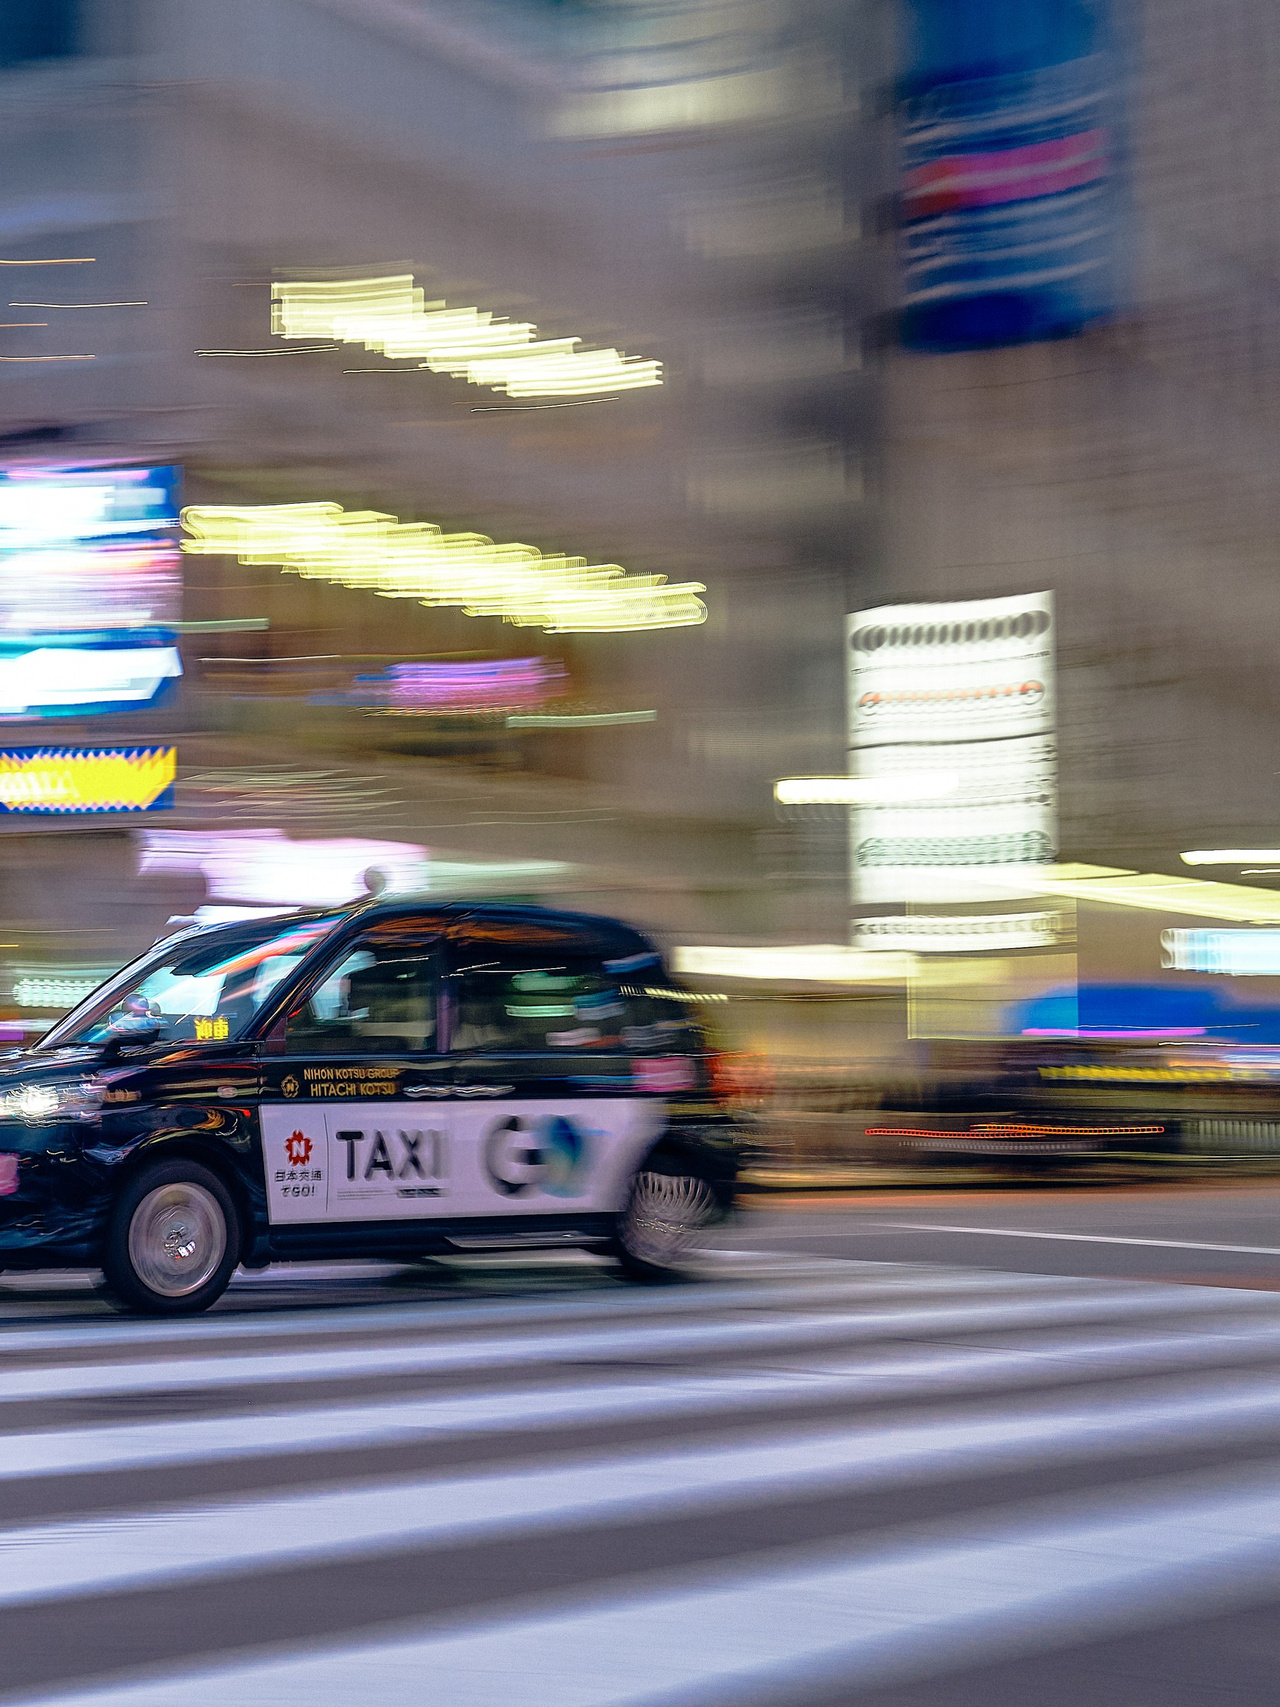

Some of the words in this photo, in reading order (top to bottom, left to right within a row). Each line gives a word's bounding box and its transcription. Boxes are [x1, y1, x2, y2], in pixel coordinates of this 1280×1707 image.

[303, 1069, 334, 1080] NIHON
[336, 1068, 366, 1079] KOTSU
[310, 1083, 356, 1097] HITACHI
[360, 1082, 396, 1095] KOTSU
[336, 1131, 446, 1181] TAXI
[275, 1169, 322, 1182] 日本交通
